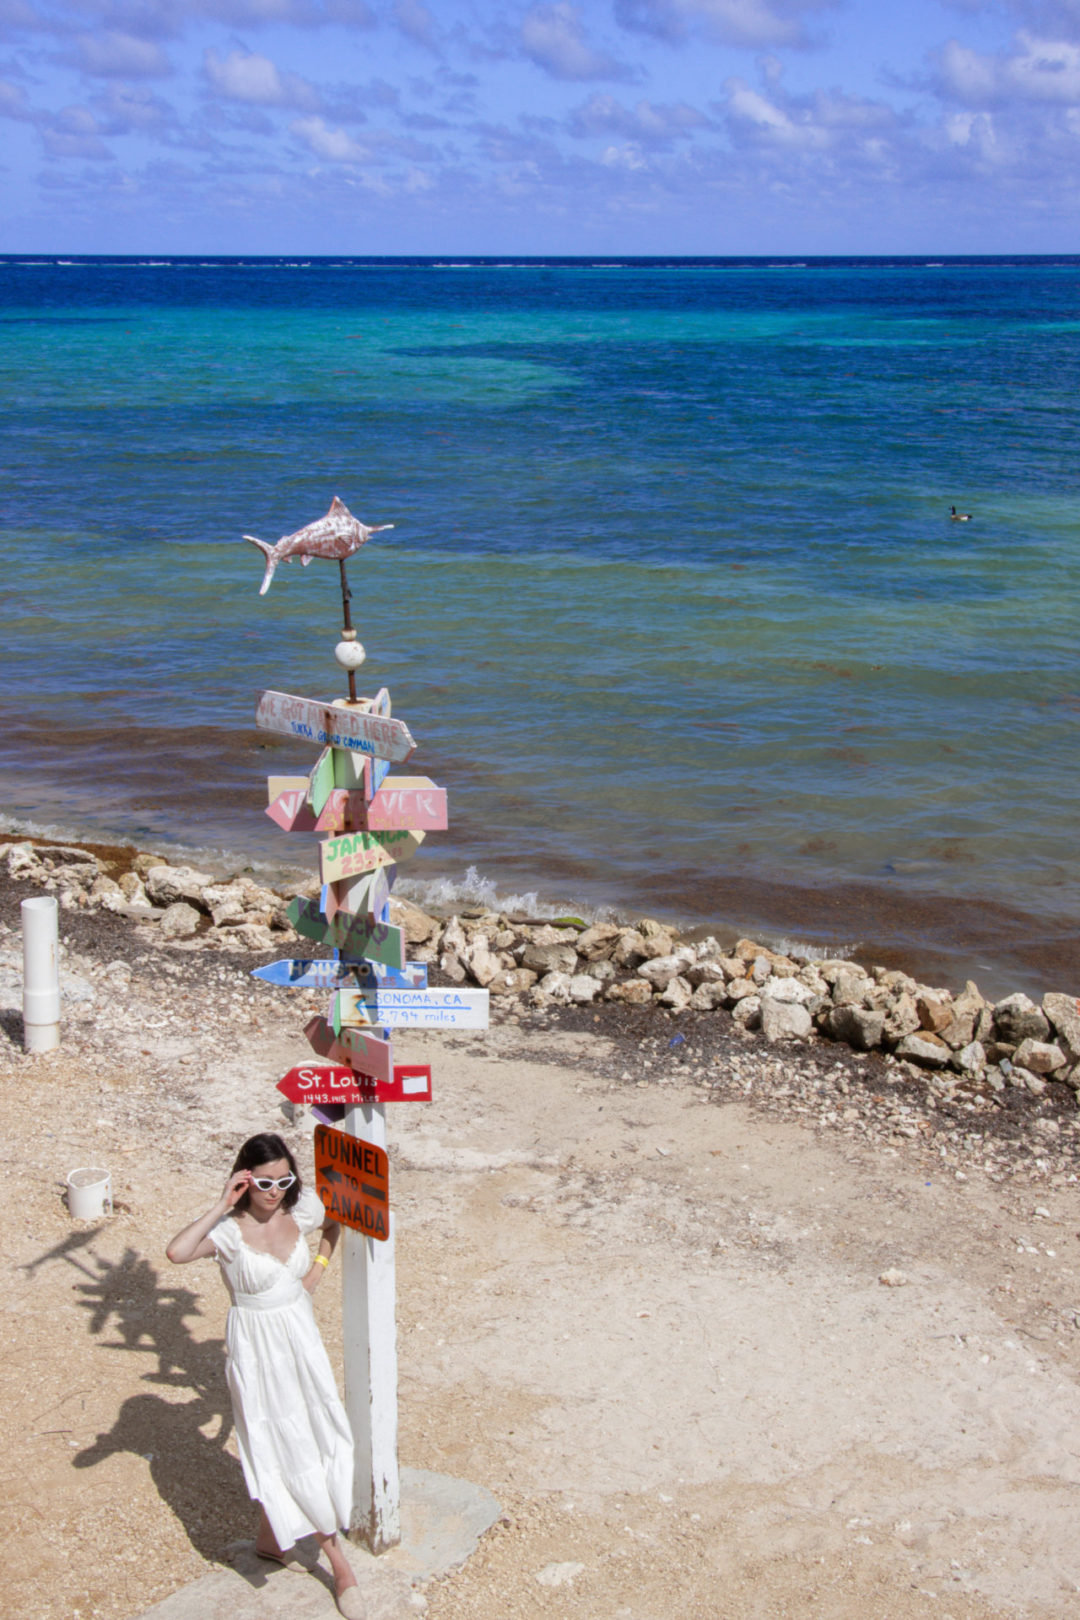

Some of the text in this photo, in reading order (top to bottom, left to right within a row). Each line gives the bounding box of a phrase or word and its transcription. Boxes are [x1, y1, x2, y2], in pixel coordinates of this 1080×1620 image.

[297, 899, 389, 945] KEUCKY
[288, 960, 387, 977] HOUSTON
[443, 992, 462, 1005] CA
[424, 1010, 456, 1023] miles
[297, 1069, 325, 1089] St.
[318, 1131, 386, 1180] TUNNEL
[343, 1173, 359, 1191] TO
[319, 1186, 387, 1237] CANADA
